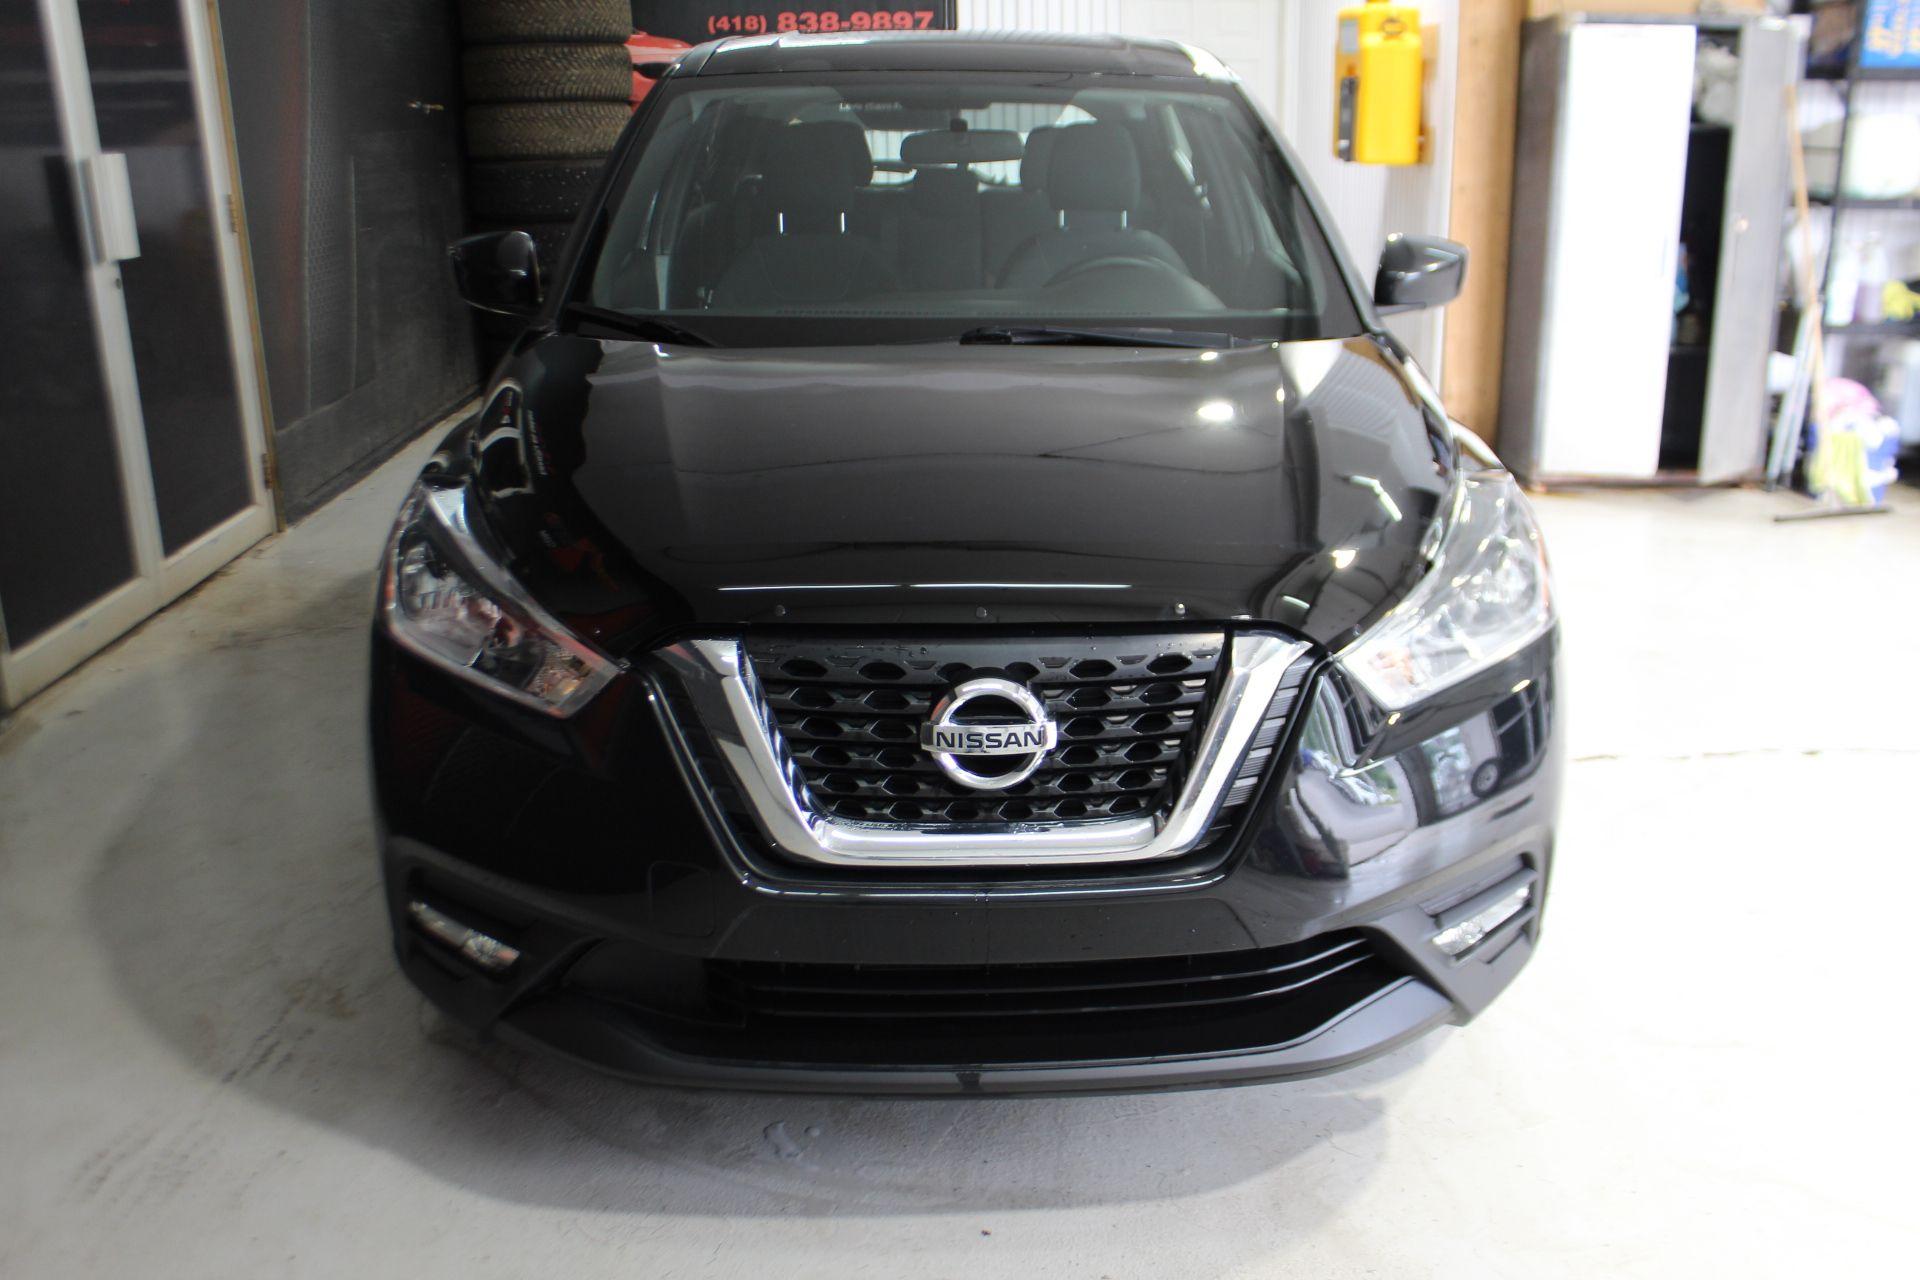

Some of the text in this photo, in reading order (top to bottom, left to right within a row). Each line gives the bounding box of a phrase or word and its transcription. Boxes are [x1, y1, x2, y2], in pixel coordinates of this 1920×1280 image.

[708, 11, 934, 34] (418) 838-9897
[936, 731, 1042, 749] NISSAN
